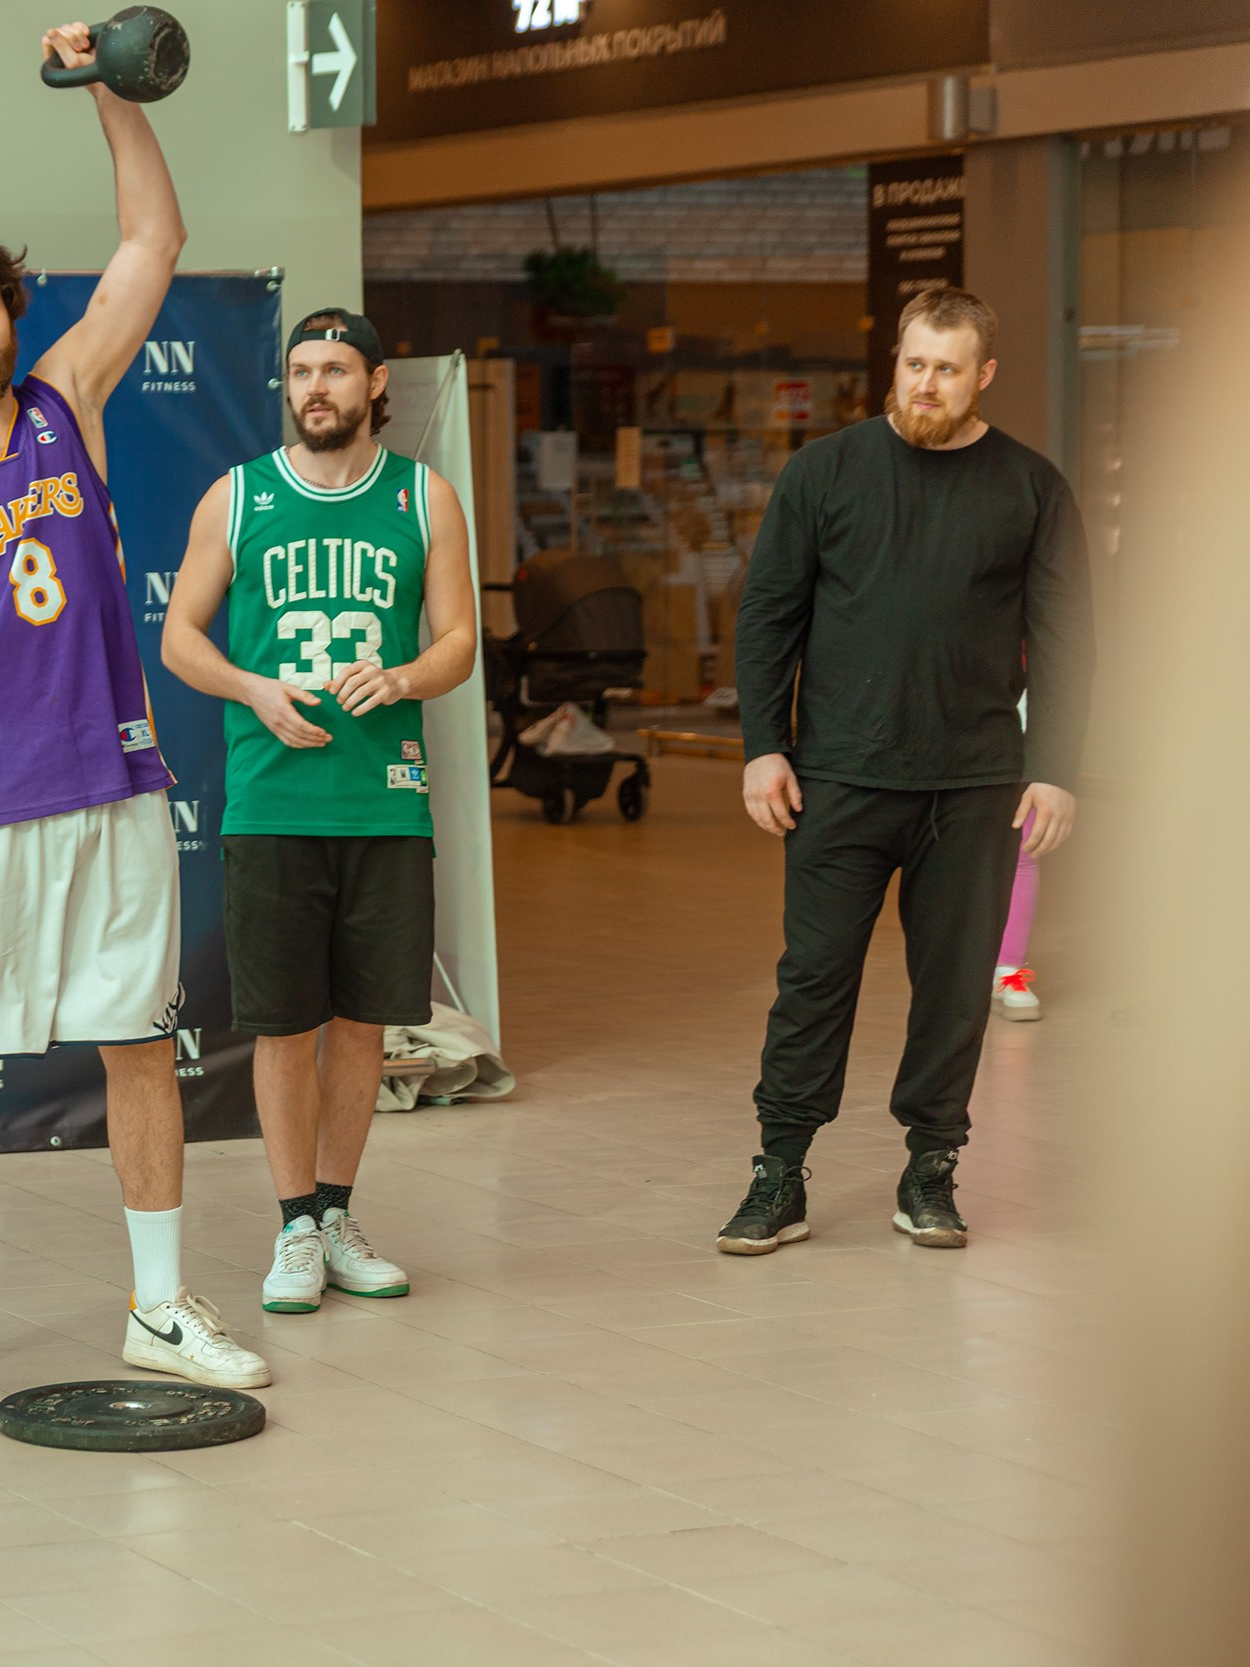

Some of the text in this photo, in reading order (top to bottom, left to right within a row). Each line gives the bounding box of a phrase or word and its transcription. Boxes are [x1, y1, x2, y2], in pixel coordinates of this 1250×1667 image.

[145, 341, 195, 374] NN
[142, 381, 196, 392] FITNESS
[8, 537, 68, 627] 8
[145, 572, 179, 605] N
[263, 538, 398, 609] CELTICS
[277, 610, 383, 691] 33
[168, 800, 199, 833] N
[175, 1028, 202, 1061] N
